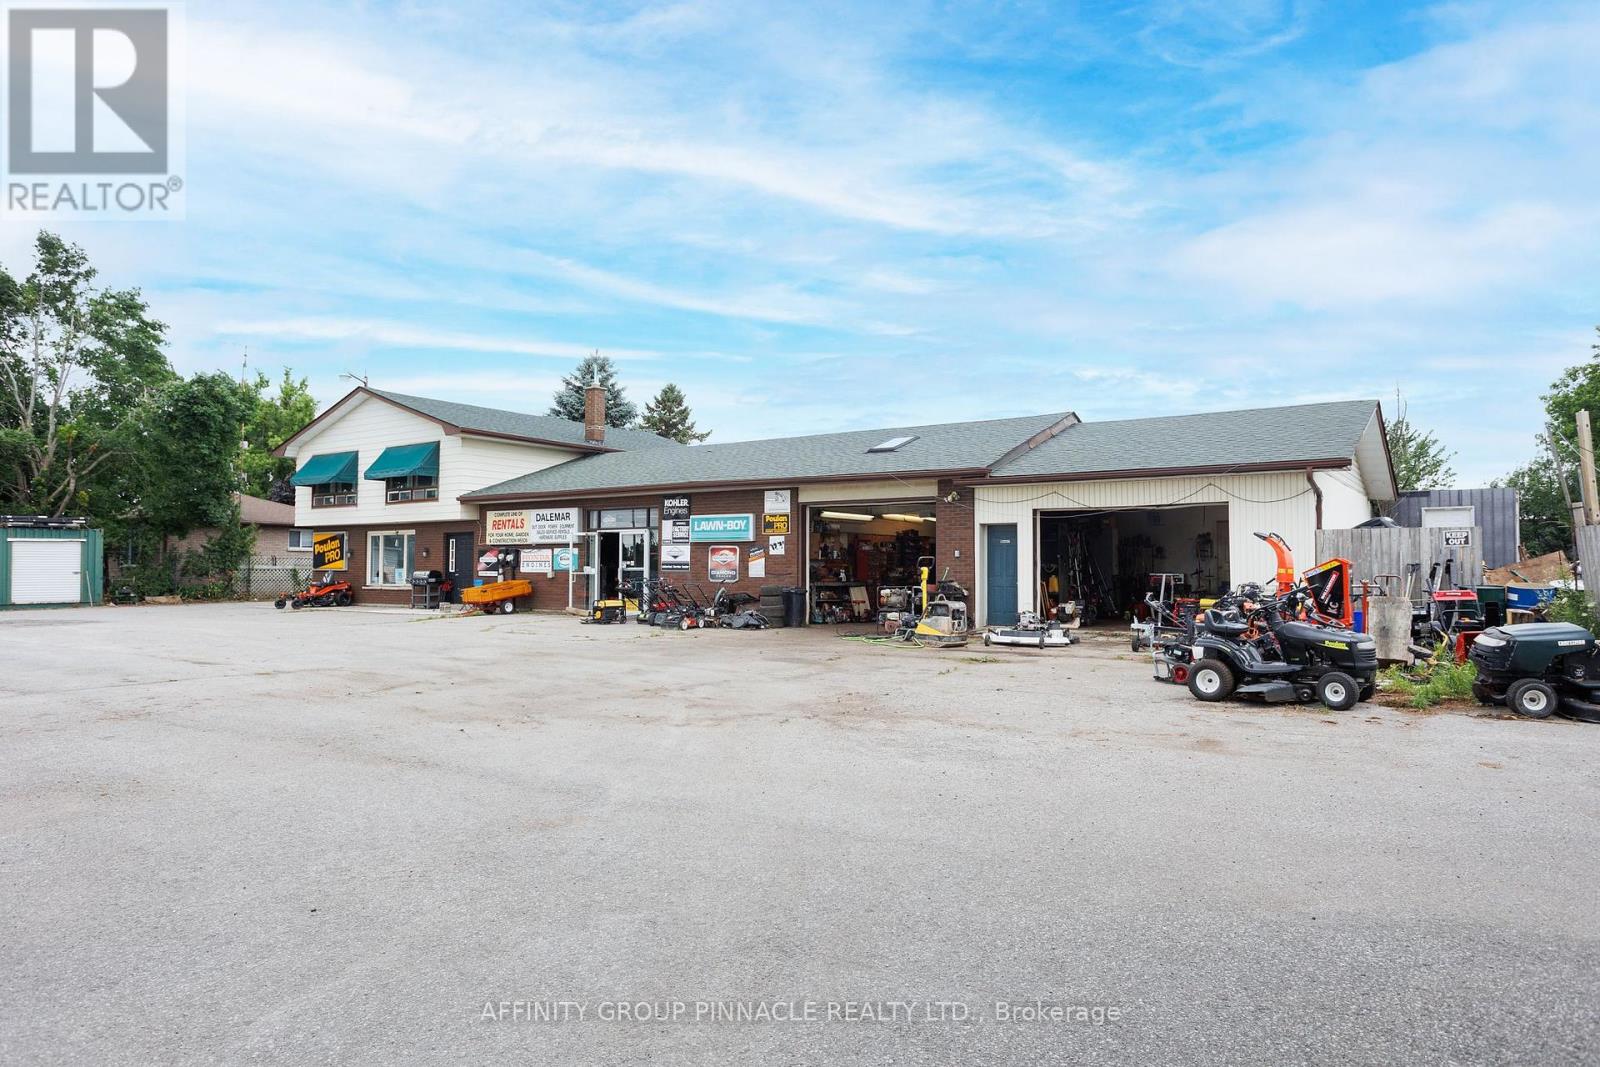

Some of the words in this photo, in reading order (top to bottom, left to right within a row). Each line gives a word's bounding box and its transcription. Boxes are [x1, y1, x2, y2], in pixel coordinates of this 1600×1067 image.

[664, 499, 689, 507] KOHLER
[663, 507, 688, 516] Engines
[535, 512, 571, 522] DALEMAR
[765, 514, 788, 522] Poulan
[492, 518, 525, 530] RENTALS
[694, 520, 747, 532] LAWN-BOY
[1446, 531, 1468, 539] KEEP
[315, 539, 340, 555] Poulan
[325, 549, 341, 563] PRO
